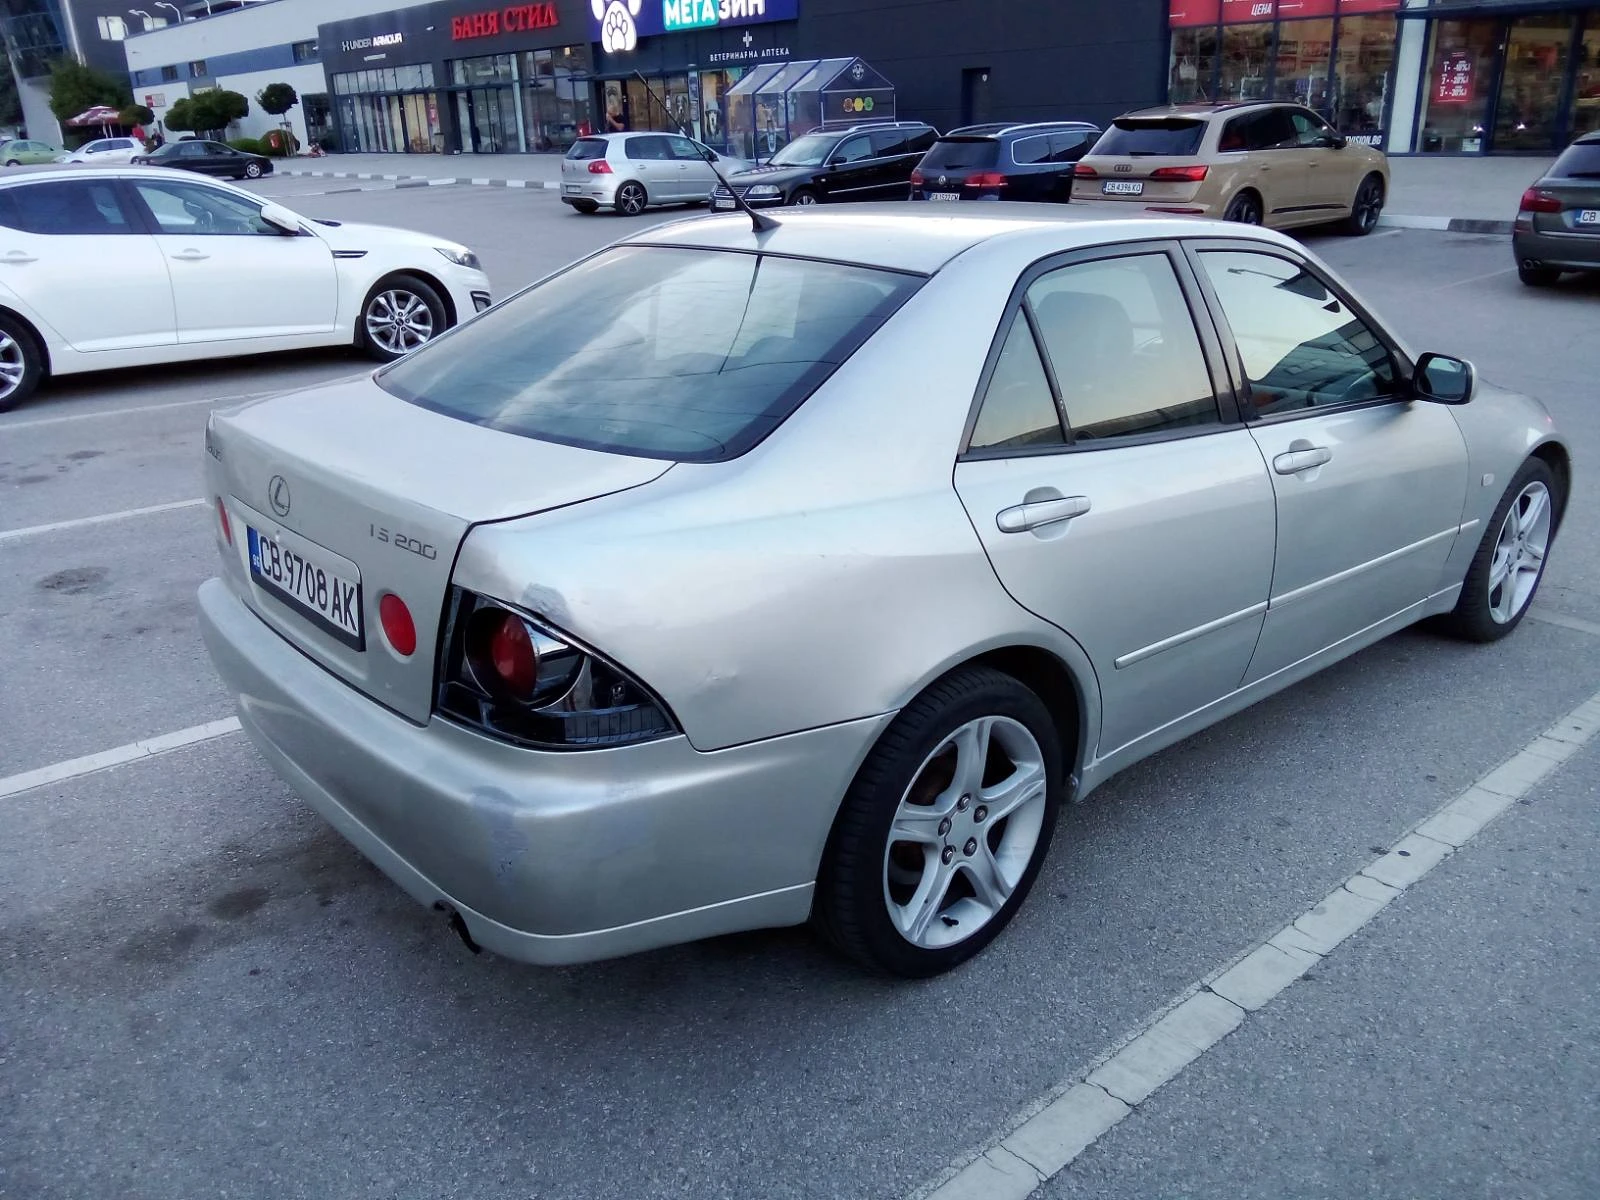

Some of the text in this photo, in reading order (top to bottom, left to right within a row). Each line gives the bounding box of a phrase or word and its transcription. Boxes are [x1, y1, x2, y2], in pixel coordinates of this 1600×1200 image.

[1251, 2, 1272, 16] ЦЕНА
[452, 3, 559, 40] БАНЯ СТИЛ
[350, 32, 402, 49] UNDER ARMOUR
[710, 47, 790, 62] ВЕТЕРИНАРНА АПТЕКА
[1583, 211, 1596, 222] CB
[394, 533, 437, 560] 200
